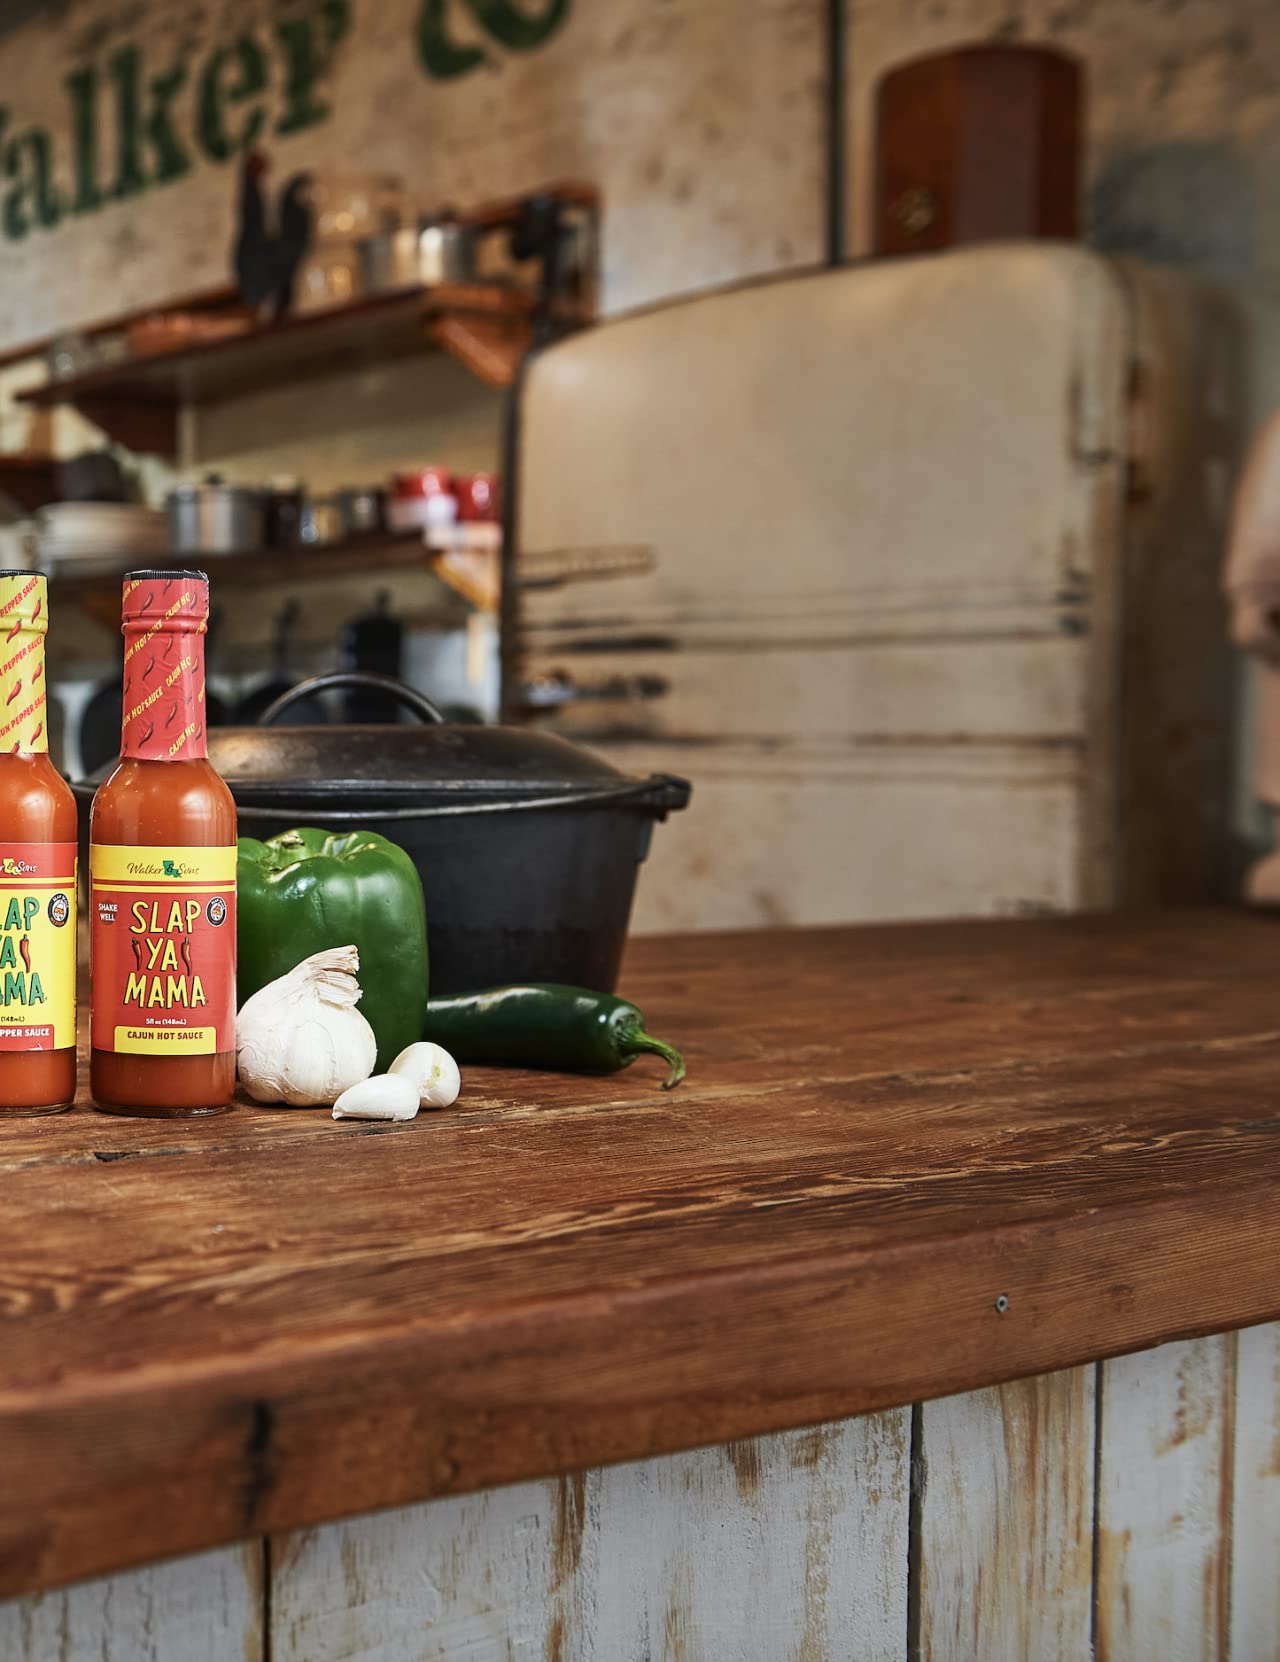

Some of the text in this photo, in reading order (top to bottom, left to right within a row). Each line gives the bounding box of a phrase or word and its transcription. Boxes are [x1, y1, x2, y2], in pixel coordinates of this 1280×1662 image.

[0, 592, 23, 617] PEPPER
[22, 576, 38, 597] SAUCE
[180, 592, 190, 606] HO
[3, 648, 27, 675] PEPPER
[27, 635, 43, 653] SAUCE
[180, 656, 192, 671] HO
[131, 701, 145, 718] HOT
[144, 686, 163, 708] SAUCE
[11, 705, 35, 729] PEPPER
[169, 722, 195, 757] CAJUN HO
[17, 861, 38, 873] Sons
[127, 863, 163, 875] Walker
[178, 862, 199, 875] Sons
[98, 903, 118, 912] SHAKE
[100, 913, 115, 921] WELL
[129, 900, 202, 934] SLAP
[145, 937, 178, 971] YA
[123, 971, 206, 1009] MAMA
[25, 1028, 49, 1036] SAUCE
[128, 1031, 154, 1039] CAJUN
[157, 1032, 175, 1040] HOT
